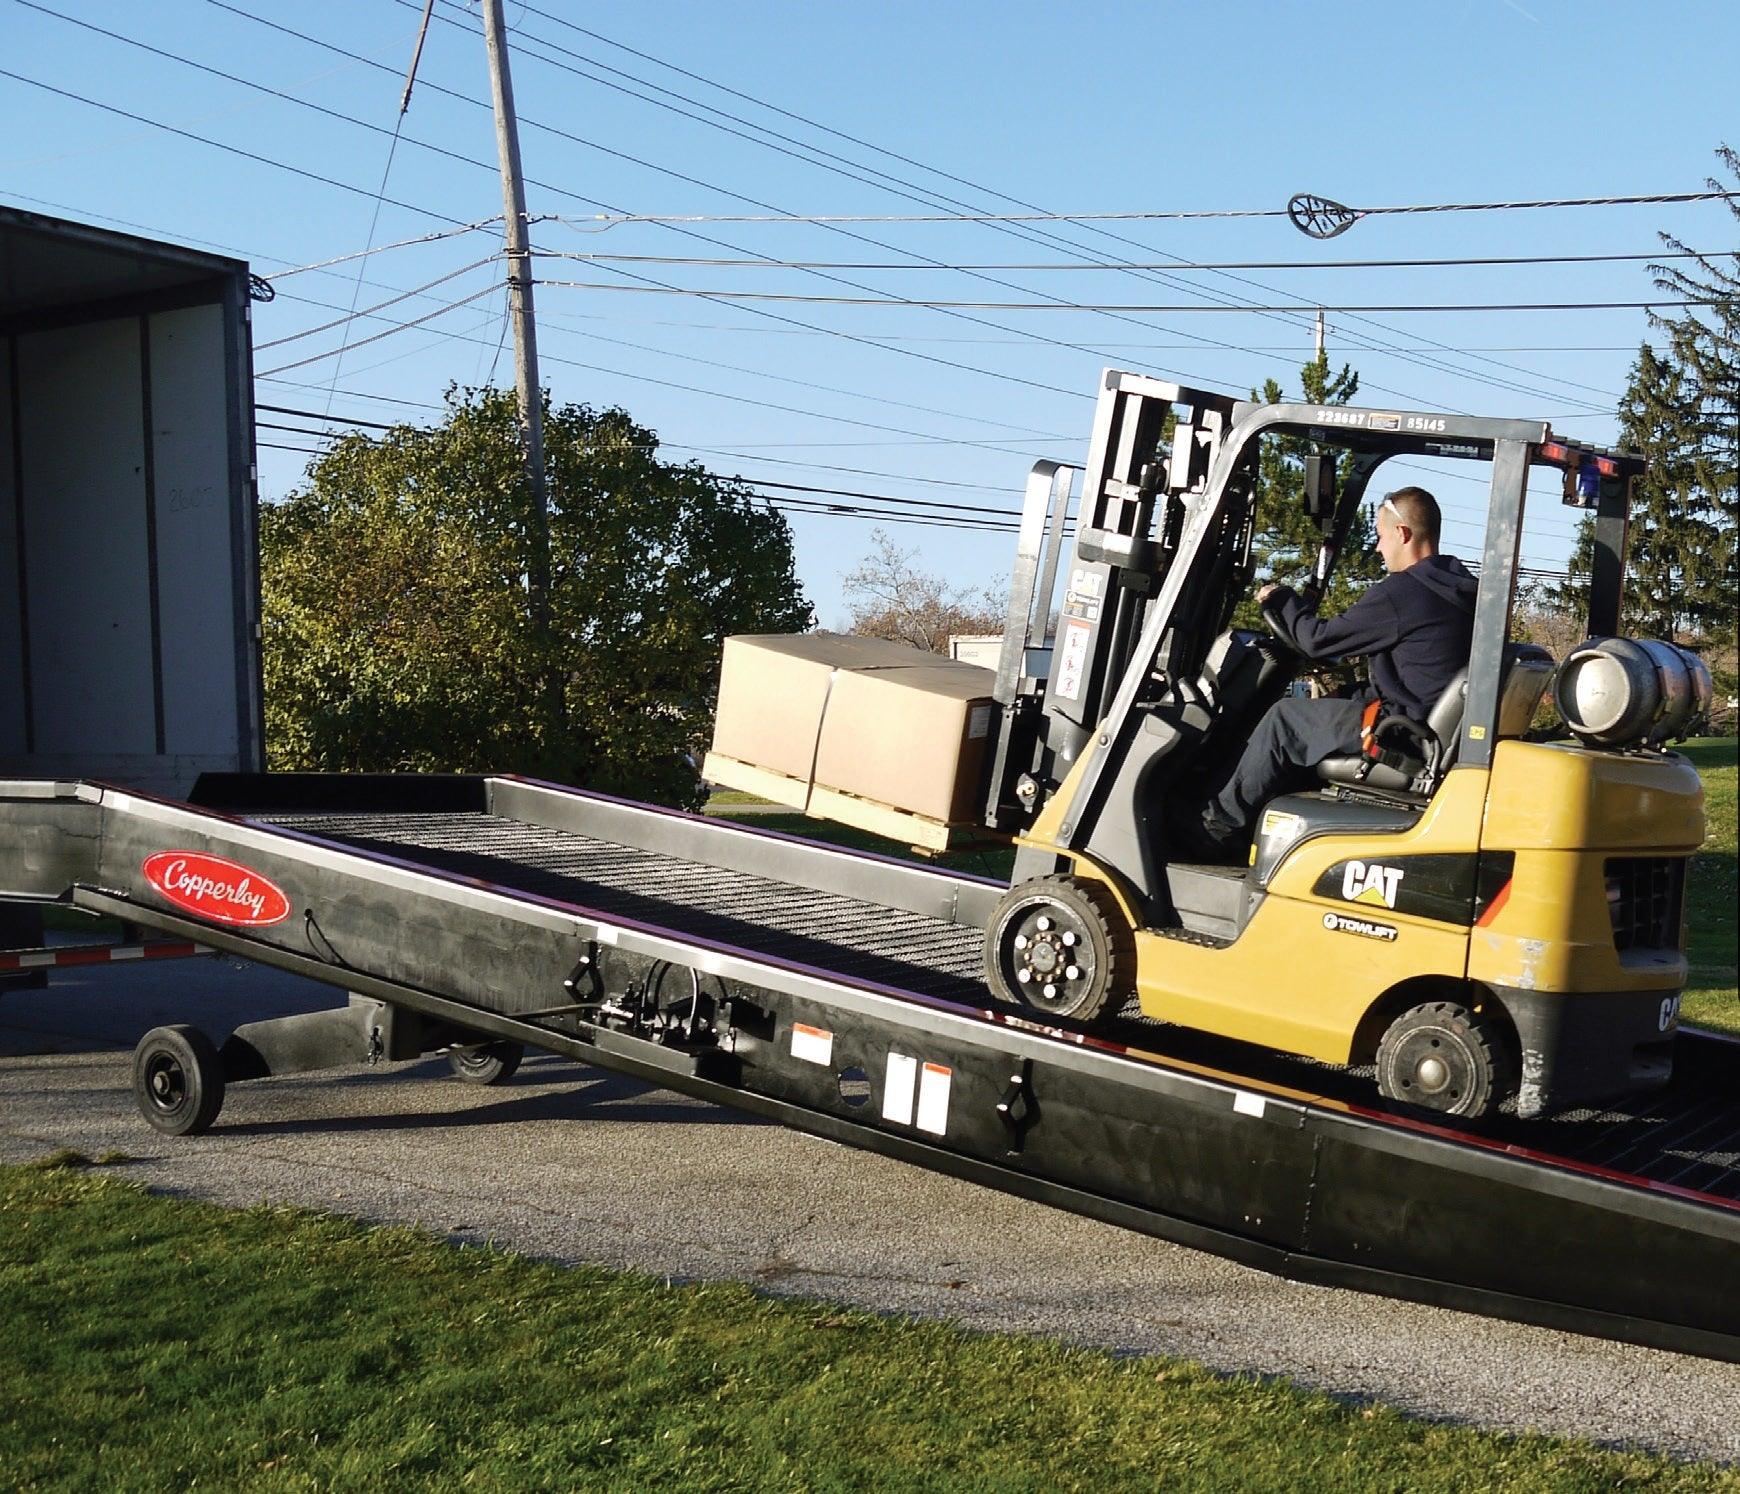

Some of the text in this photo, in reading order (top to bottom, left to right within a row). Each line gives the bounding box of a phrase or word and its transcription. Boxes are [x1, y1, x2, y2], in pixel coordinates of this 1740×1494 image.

[1407, 417, 1446, 431] 85145
[163, 859, 265, 919] Copperloy
[1342, 860, 1404, 909] CAT
[1338, 917, 1398, 940] TOWLIFT
